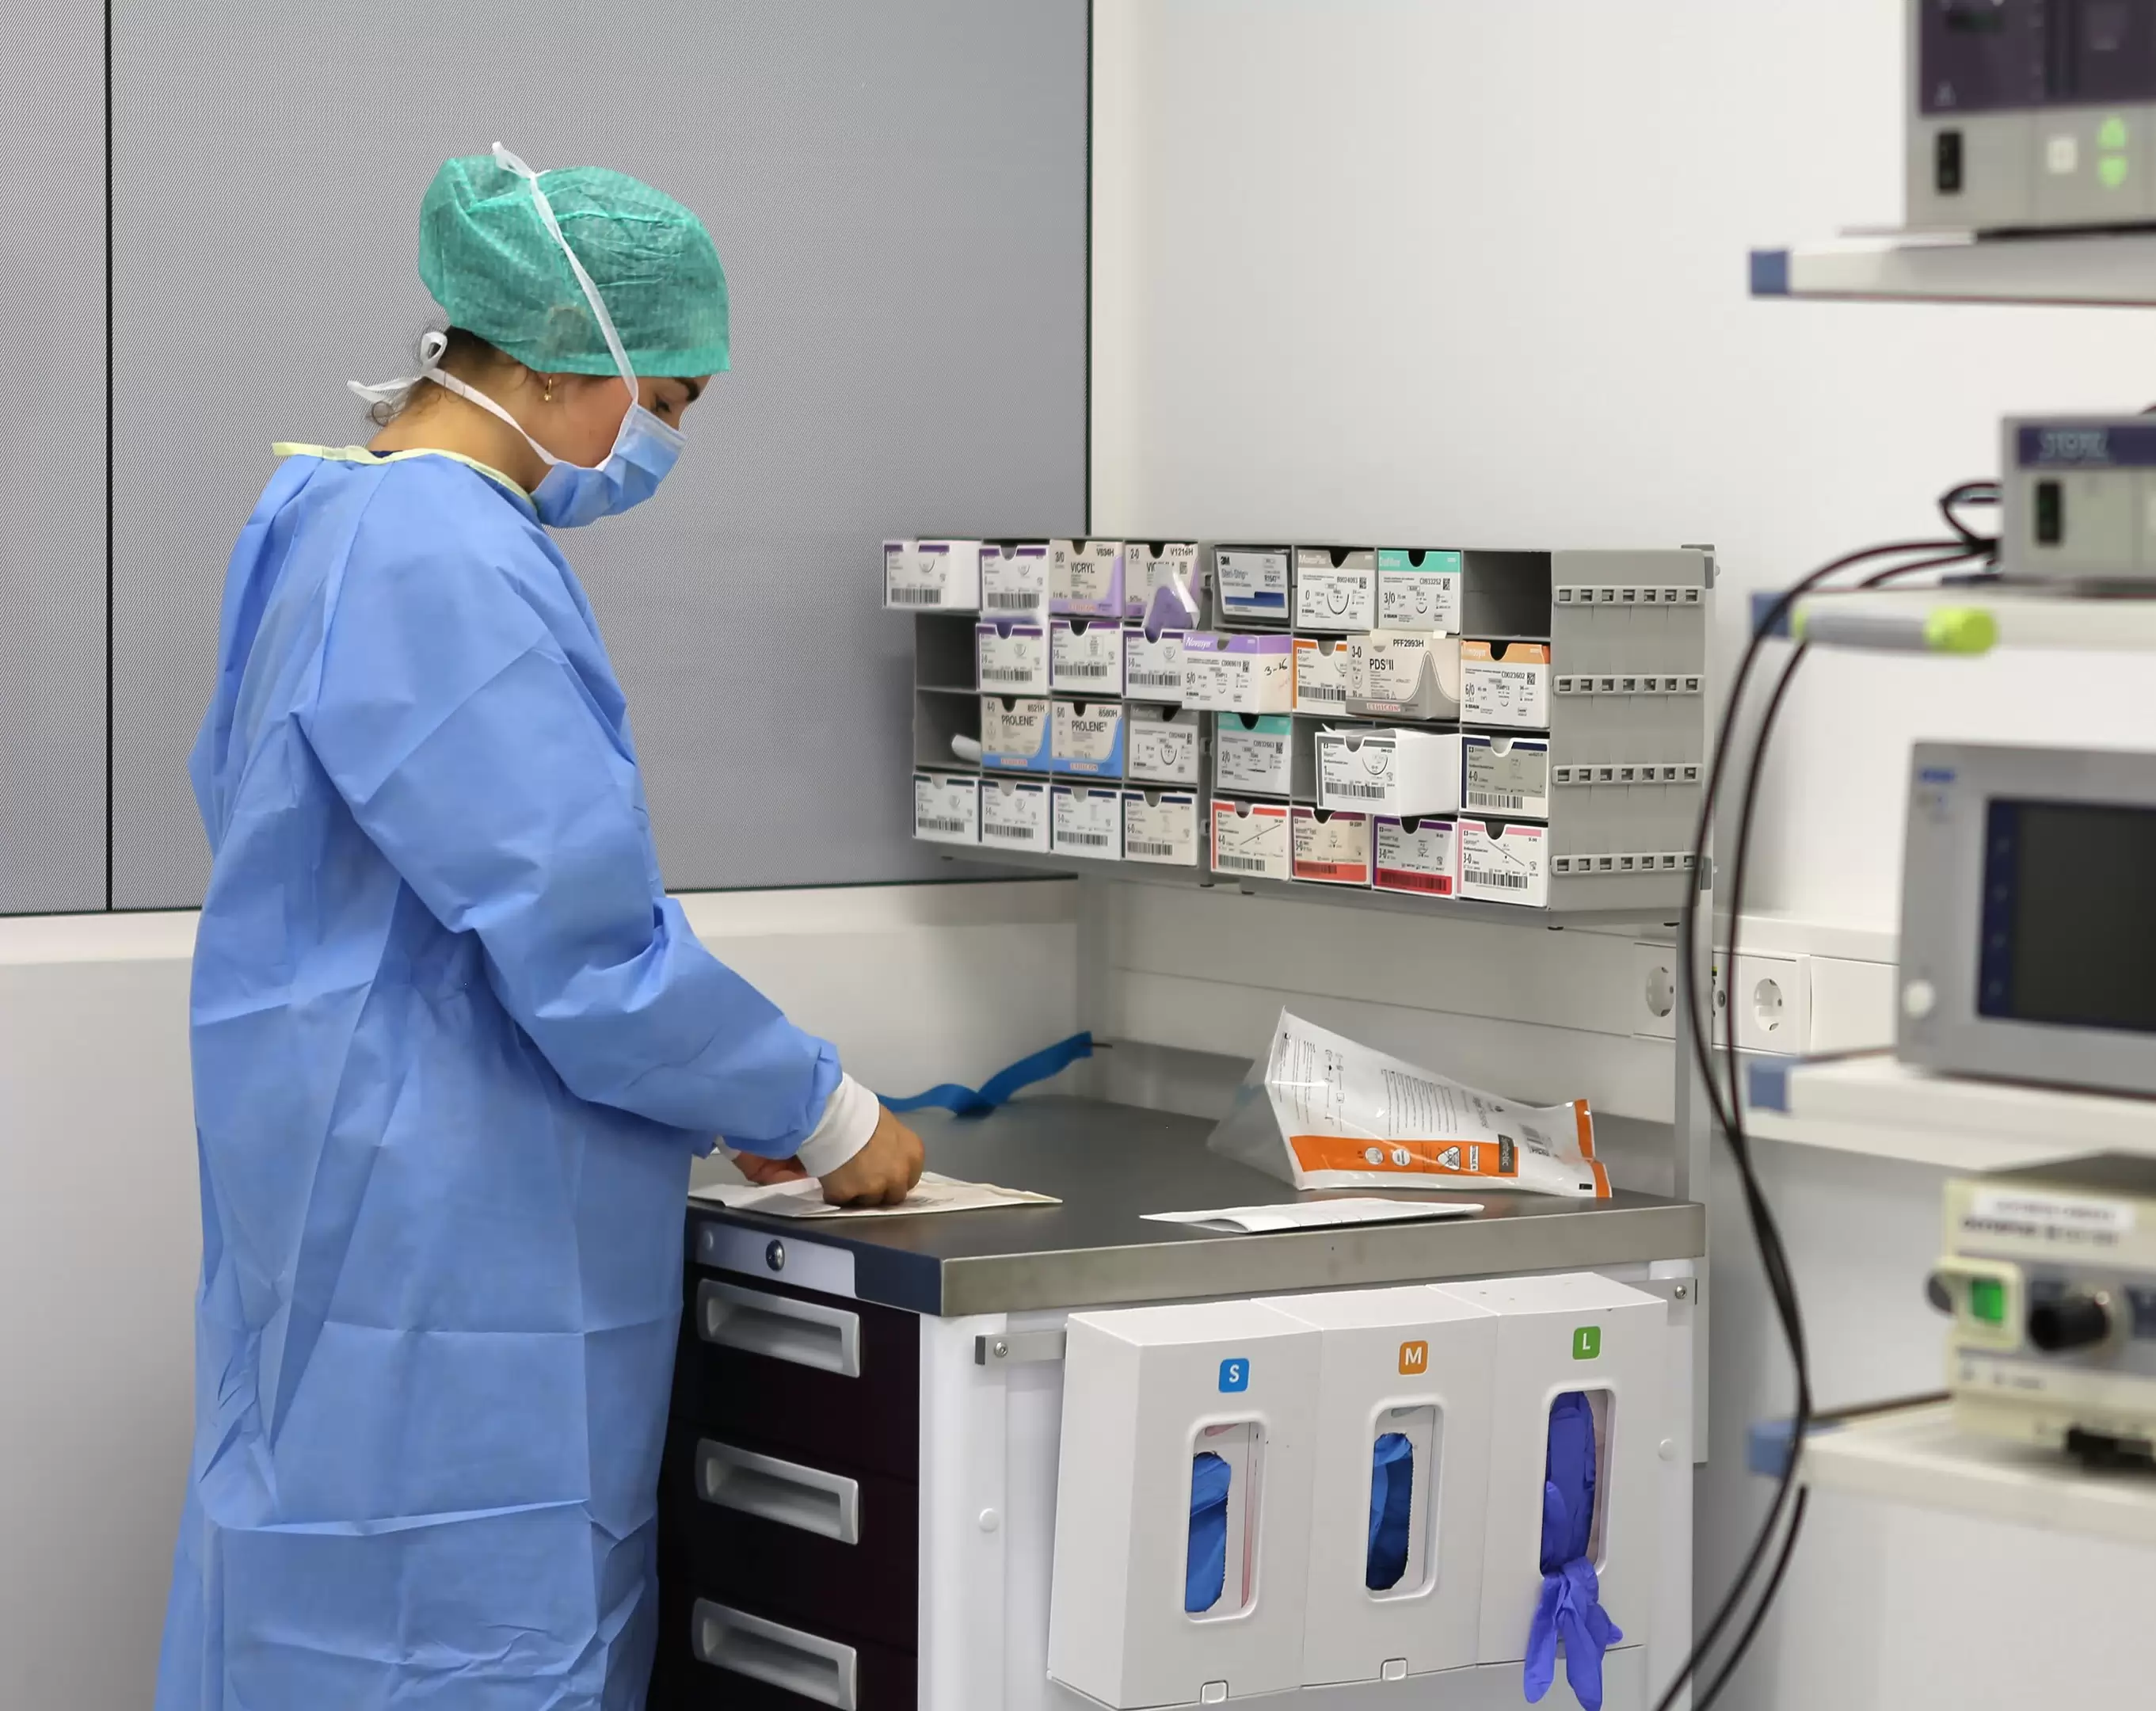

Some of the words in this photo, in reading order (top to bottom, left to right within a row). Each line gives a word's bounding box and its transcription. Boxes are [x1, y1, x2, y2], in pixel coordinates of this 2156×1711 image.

[1384, 592, 1396, 606] 3/0
[1392, 638, 1424, 648] PFF2993H
[1351, 646, 1362, 658] 3-0
[1465, 682, 1475, 697] 6/0
[1463, 852, 1472, 864] 3-0
[1583, 1332, 1590, 1351] L
[1405, 1346, 1423, 1366] M
[1229, 1364, 1239, 1383] S
